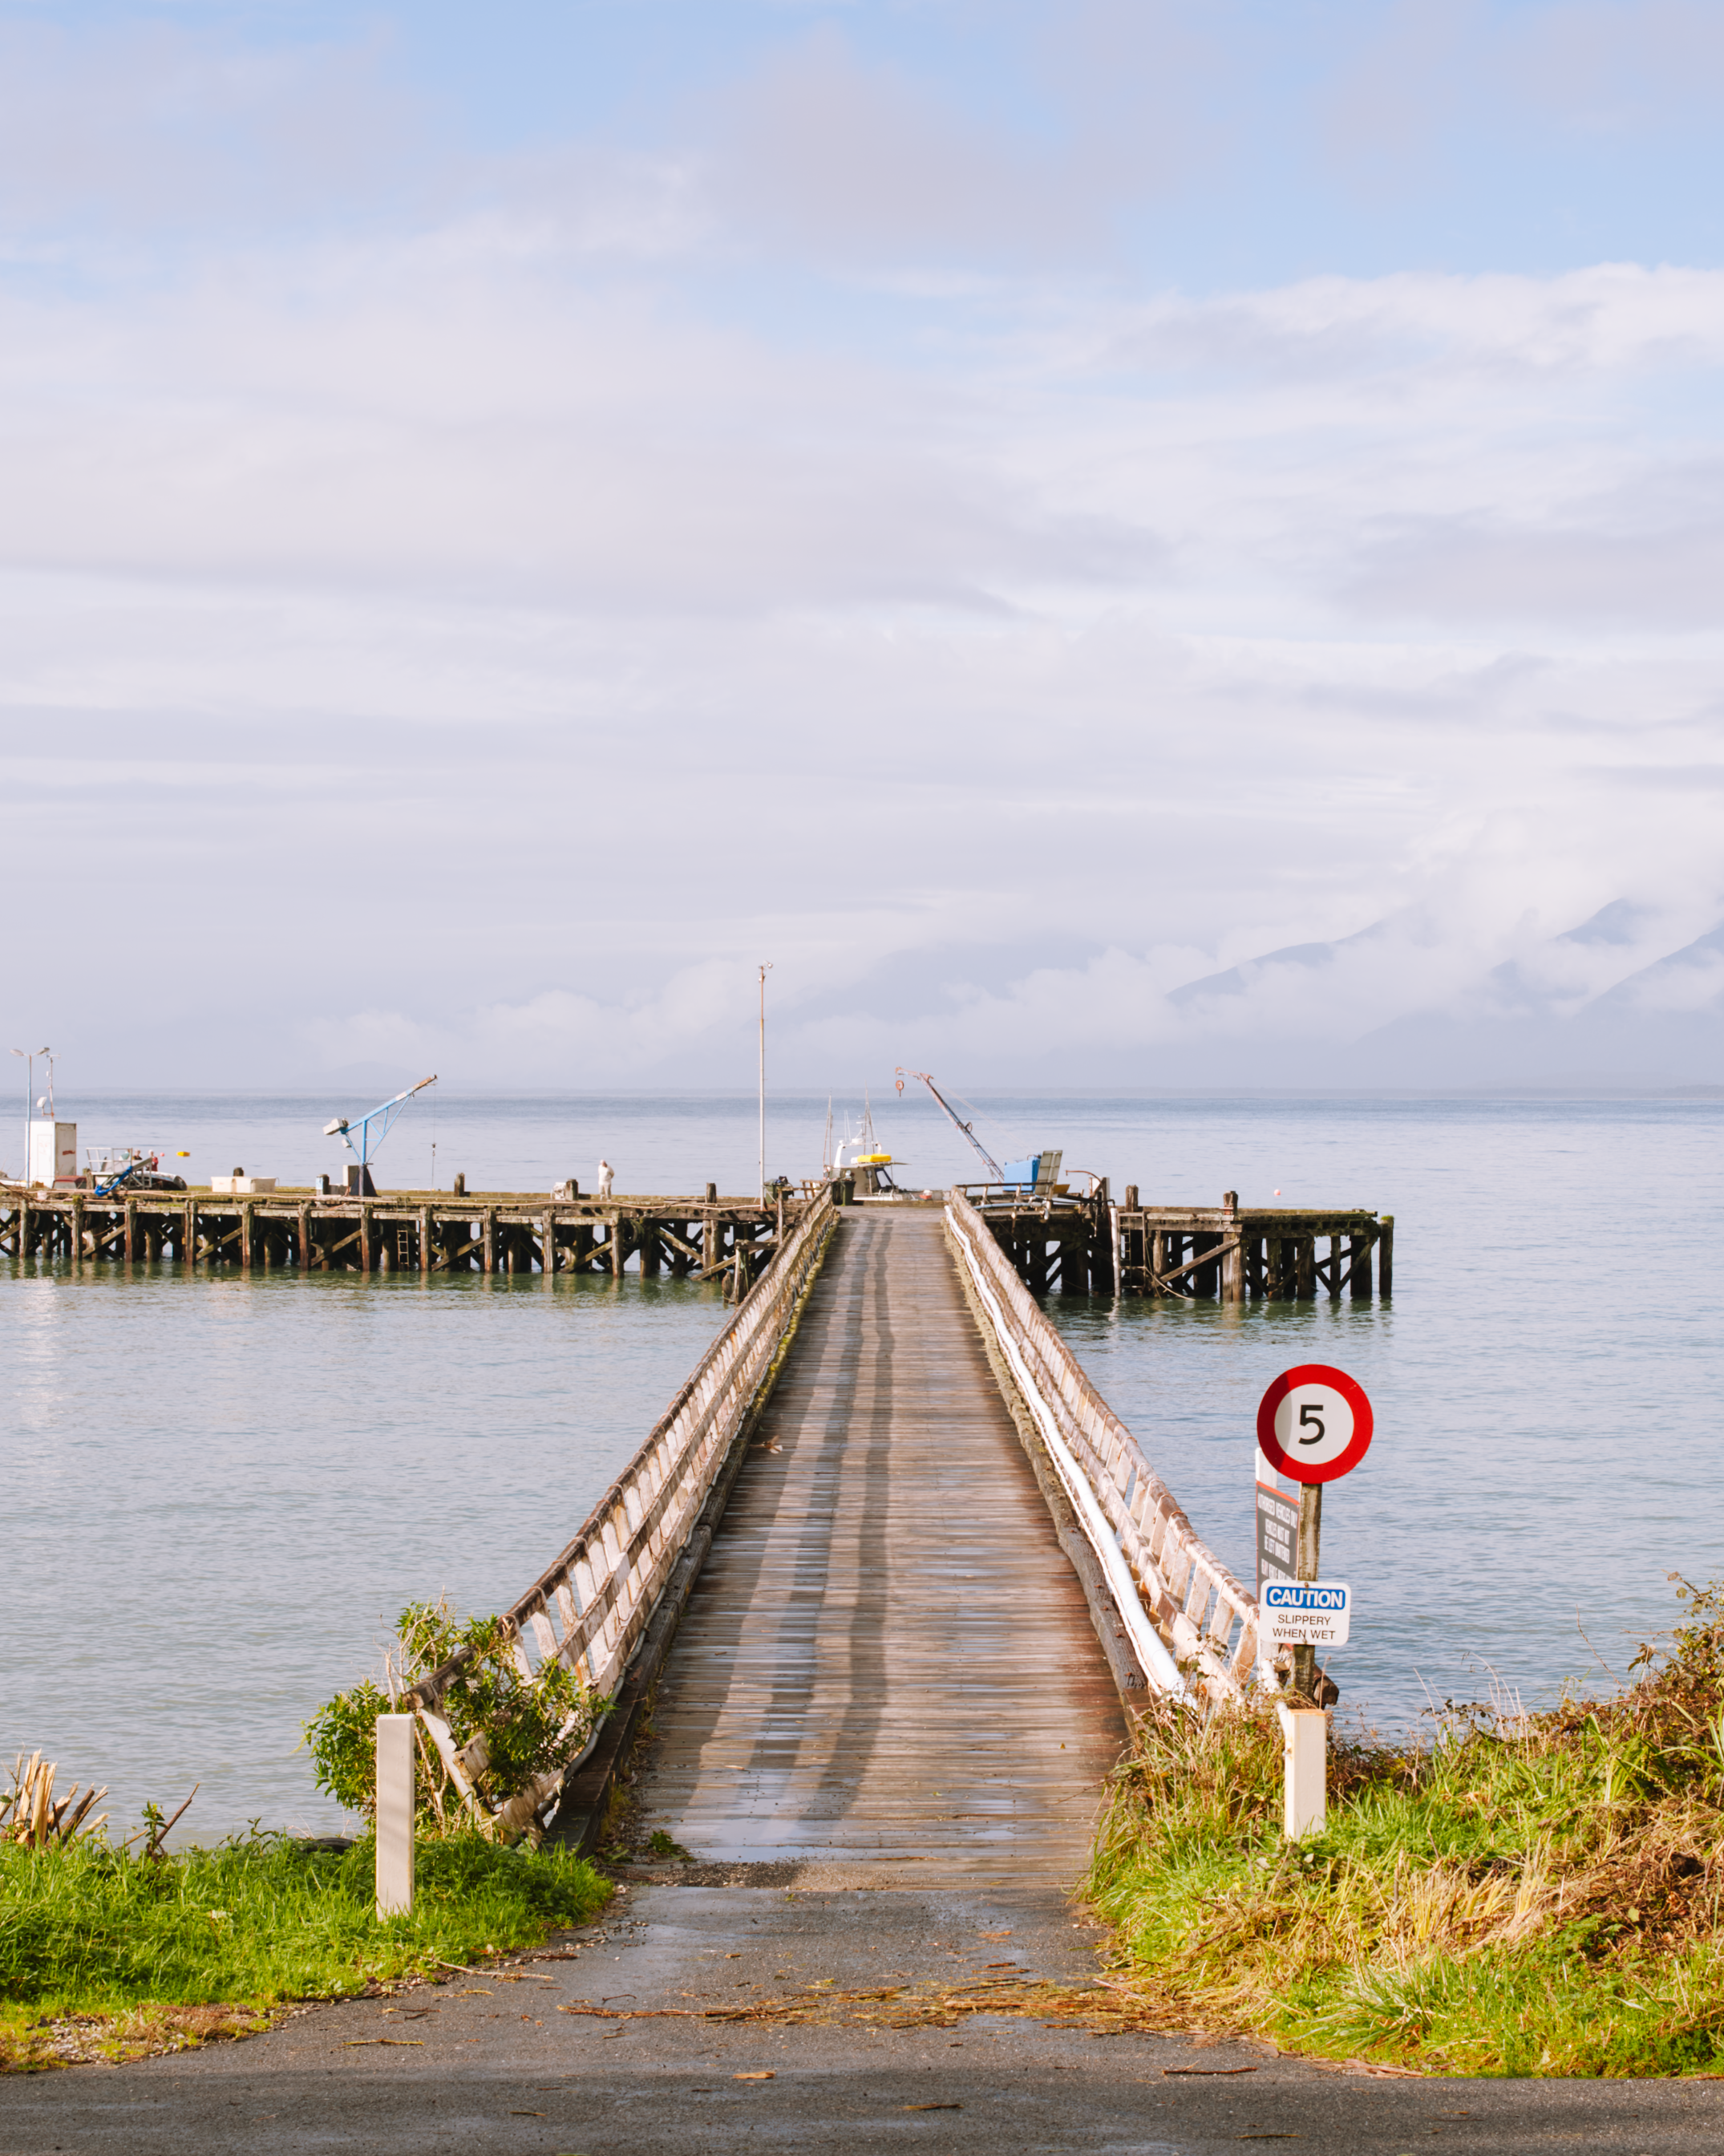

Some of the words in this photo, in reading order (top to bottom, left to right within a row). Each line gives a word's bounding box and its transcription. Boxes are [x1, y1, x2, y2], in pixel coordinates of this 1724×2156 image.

[1298, 1404, 1325, 1445] 5
[1269, 1588, 1343, 1608] CAUTION
[1277, 1614, 1331, 1626] SLIPPERY
[1273, 1627, 1306, 1639] WHEN
[1310, 1630, 1336, 1639] WET
